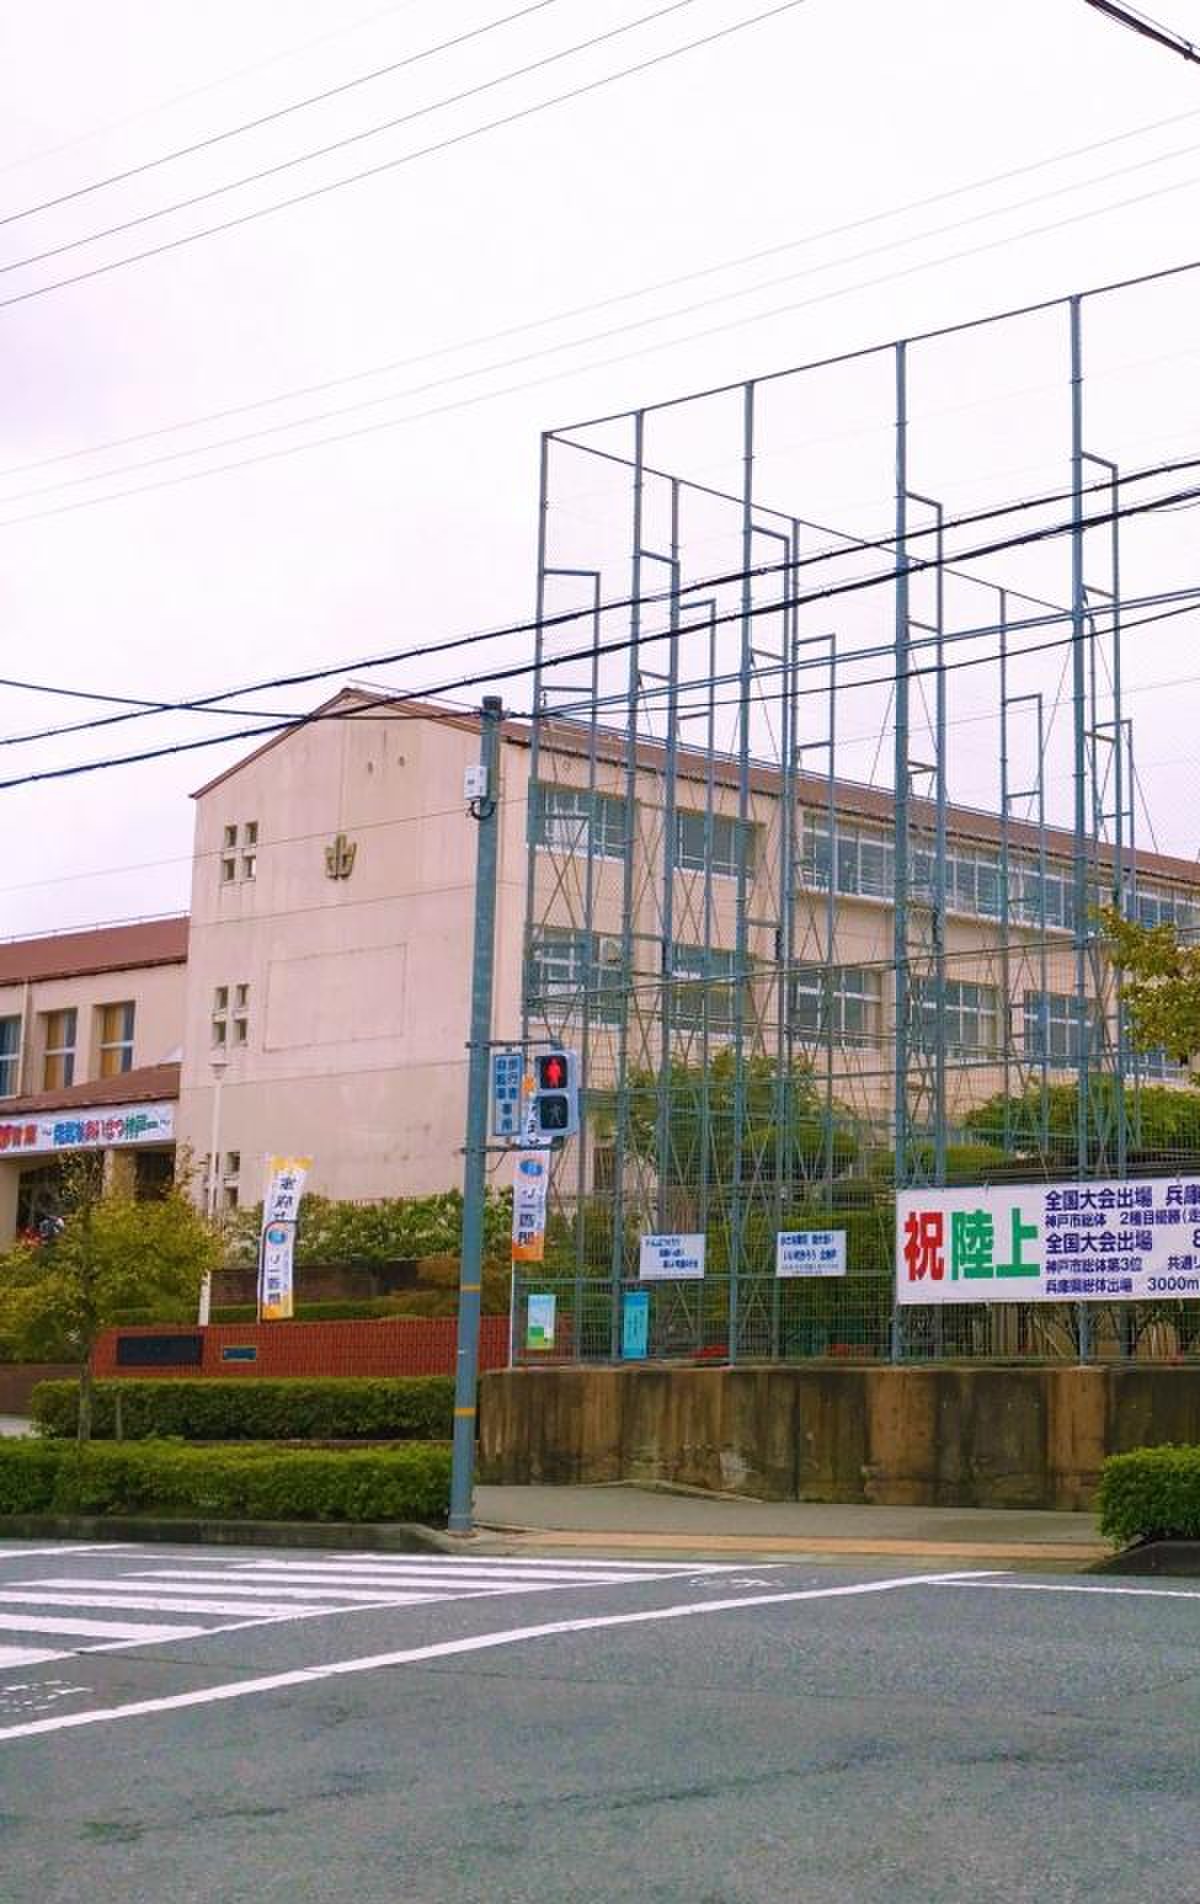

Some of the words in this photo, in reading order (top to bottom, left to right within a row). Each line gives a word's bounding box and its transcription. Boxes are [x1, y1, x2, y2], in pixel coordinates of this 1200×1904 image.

[1044, 1186, 1153, 1211] 全国大会出場
[1044, 1213, 1107, 1229] 神戸市総体
[903, 1211, 945, 1282] 祝
[951, 1207, 1041, 1282] 陸上
[1044, 1231, 1153, 1255] 全国大会出場
[1044, 1257, 1143, 1274] 神戸市総体第3位
[1044, 1278, 1133, 1294] 兵庫県総体出場
[1147, 1276, 1199, 1292] 3000m
